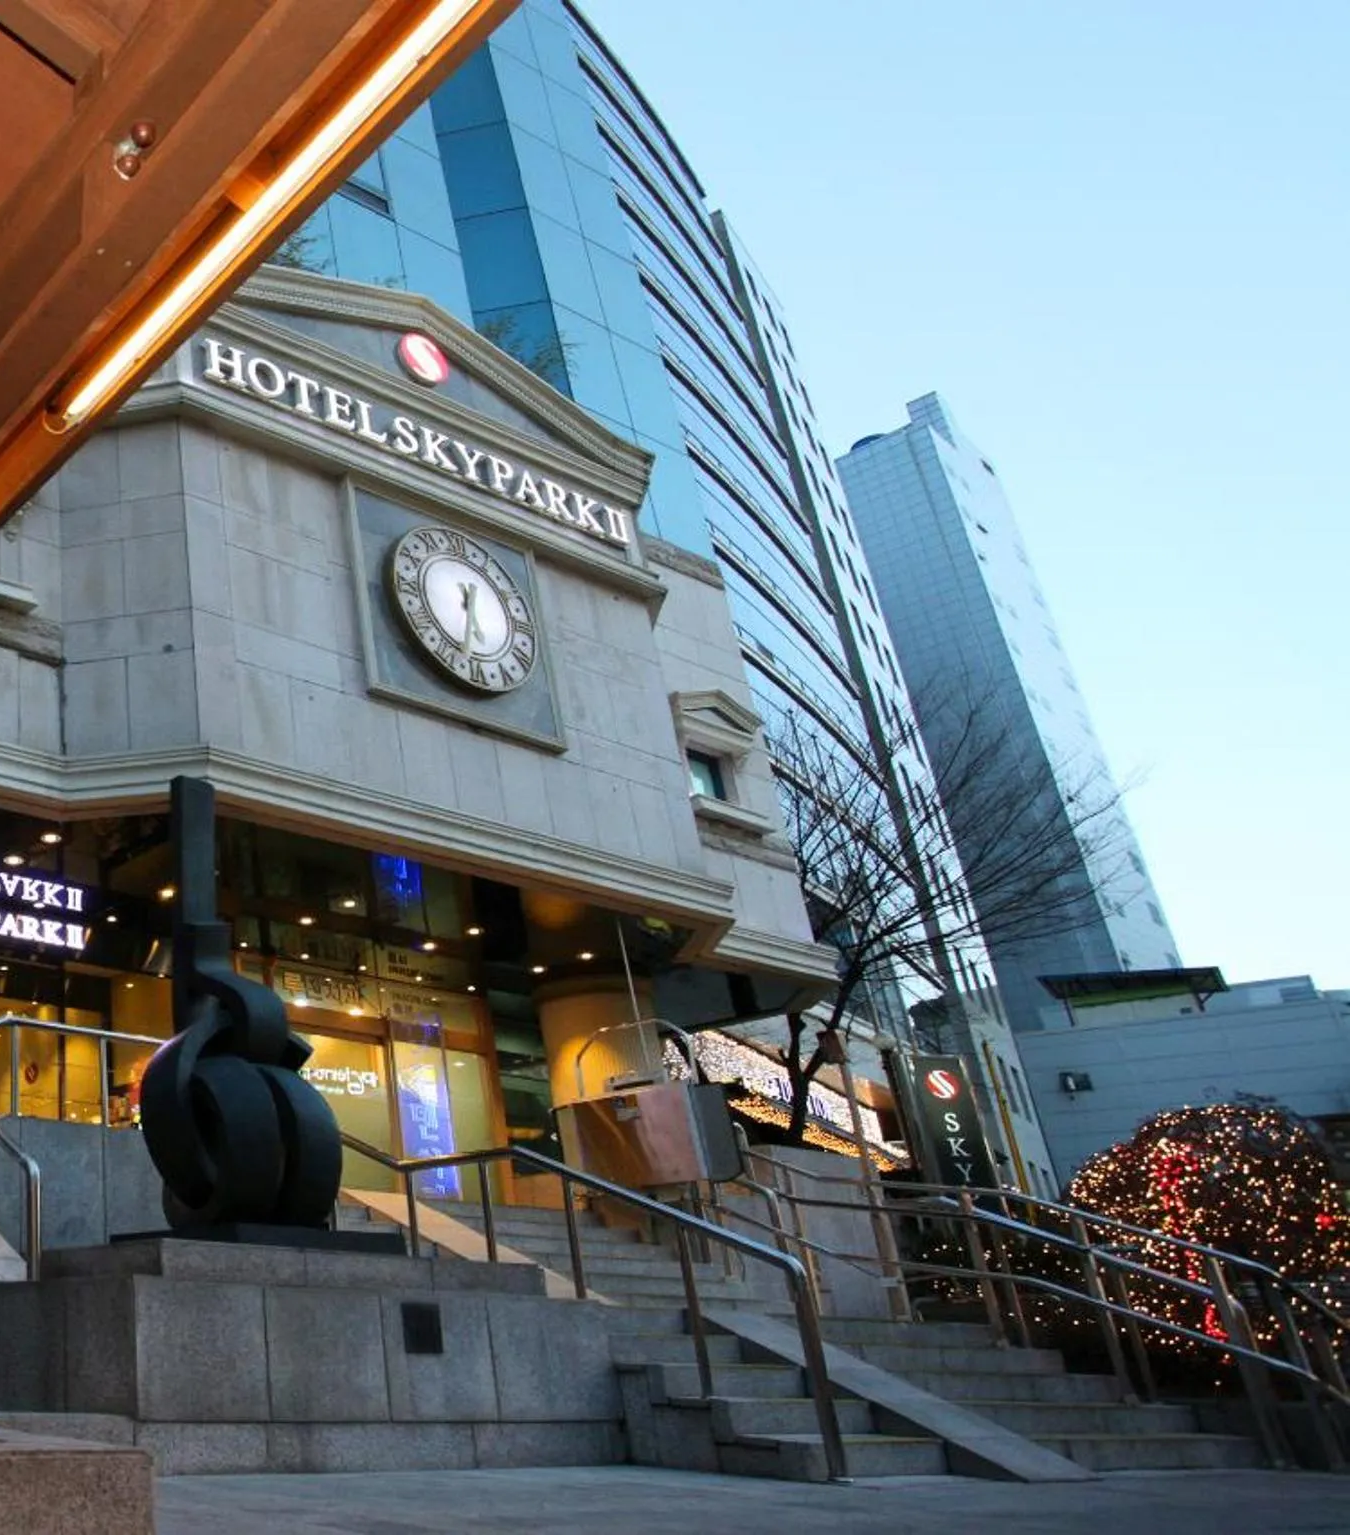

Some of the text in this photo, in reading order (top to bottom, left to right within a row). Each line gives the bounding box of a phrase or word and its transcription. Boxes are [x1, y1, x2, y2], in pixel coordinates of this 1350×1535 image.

[203, 337, 631, 544] HOTEL SKYPARK II
[64, 923, 85, 950] II
[943, 1112, 973, 1182] SKY
